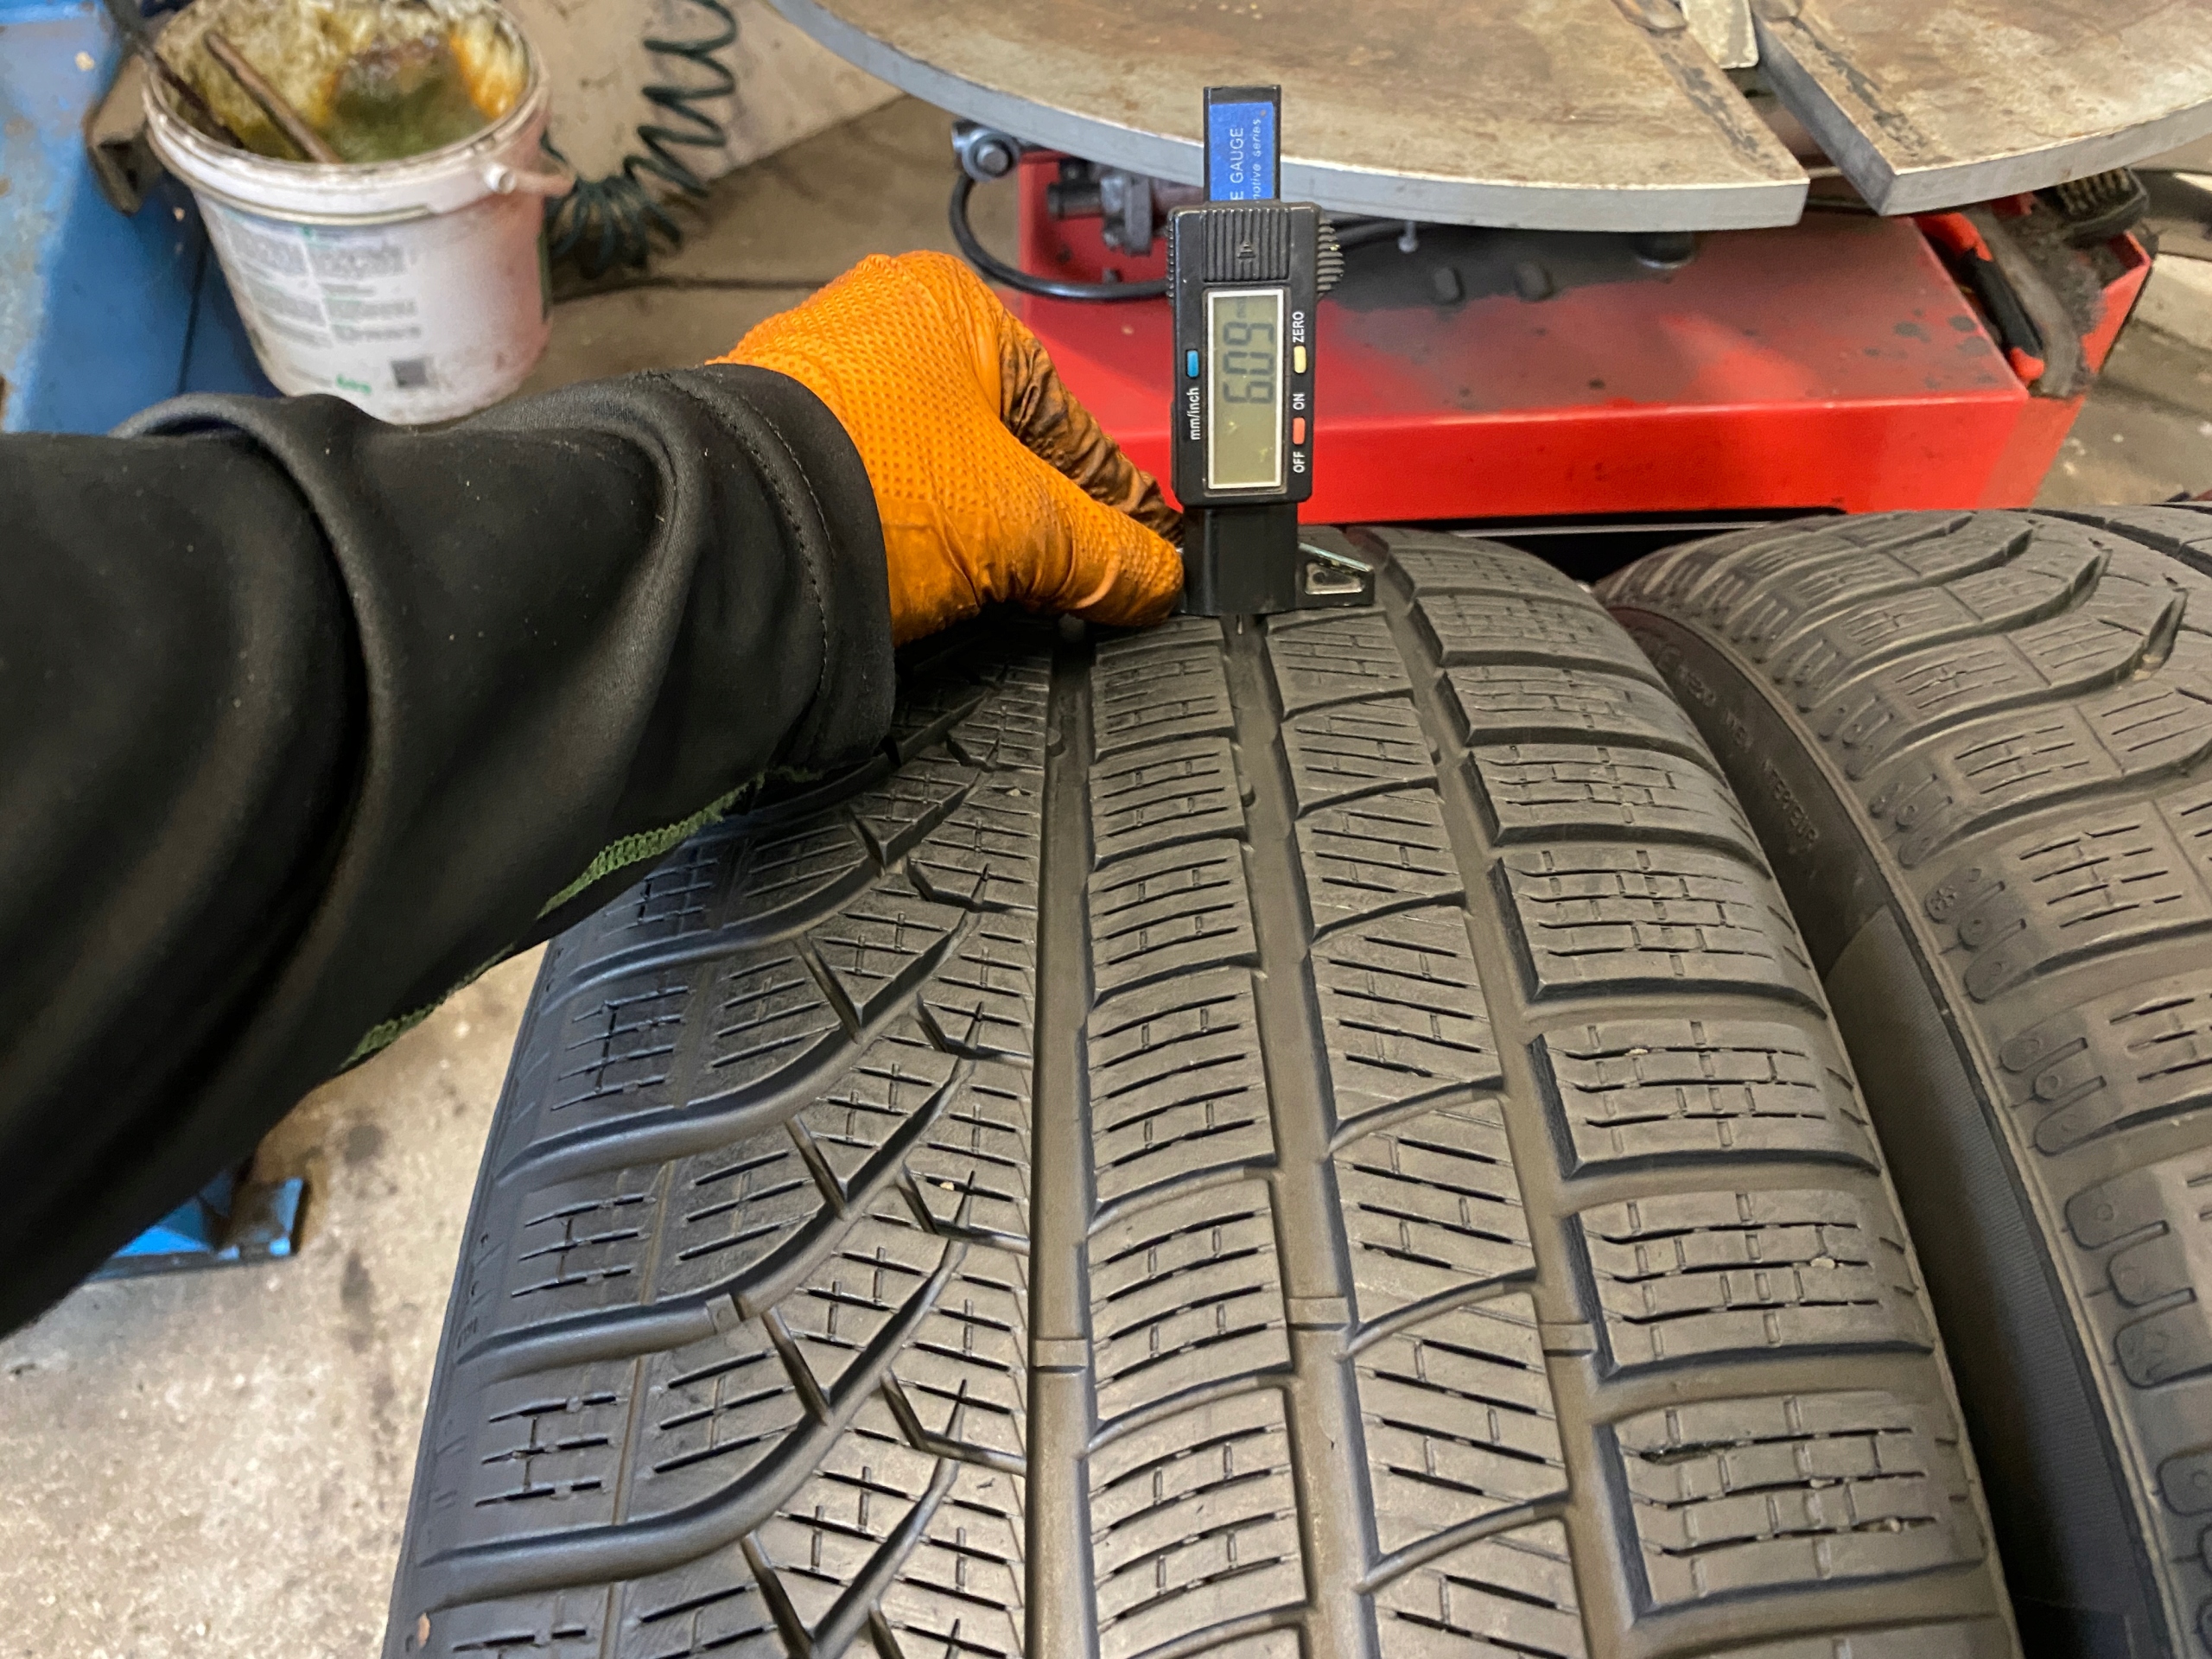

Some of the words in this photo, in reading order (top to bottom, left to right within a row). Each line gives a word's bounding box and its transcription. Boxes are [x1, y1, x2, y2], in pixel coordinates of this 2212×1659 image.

[1253, 118, 1262, 157] series
[1230, 127, 1244, 184] GAUGE
[1292, 311, 1305, 343] ZERO
[1186, 387, 1200, 441] mm/inch
[1293, 393, 1305, 410] ON
[1293, 451, 1306, 474] OFF
